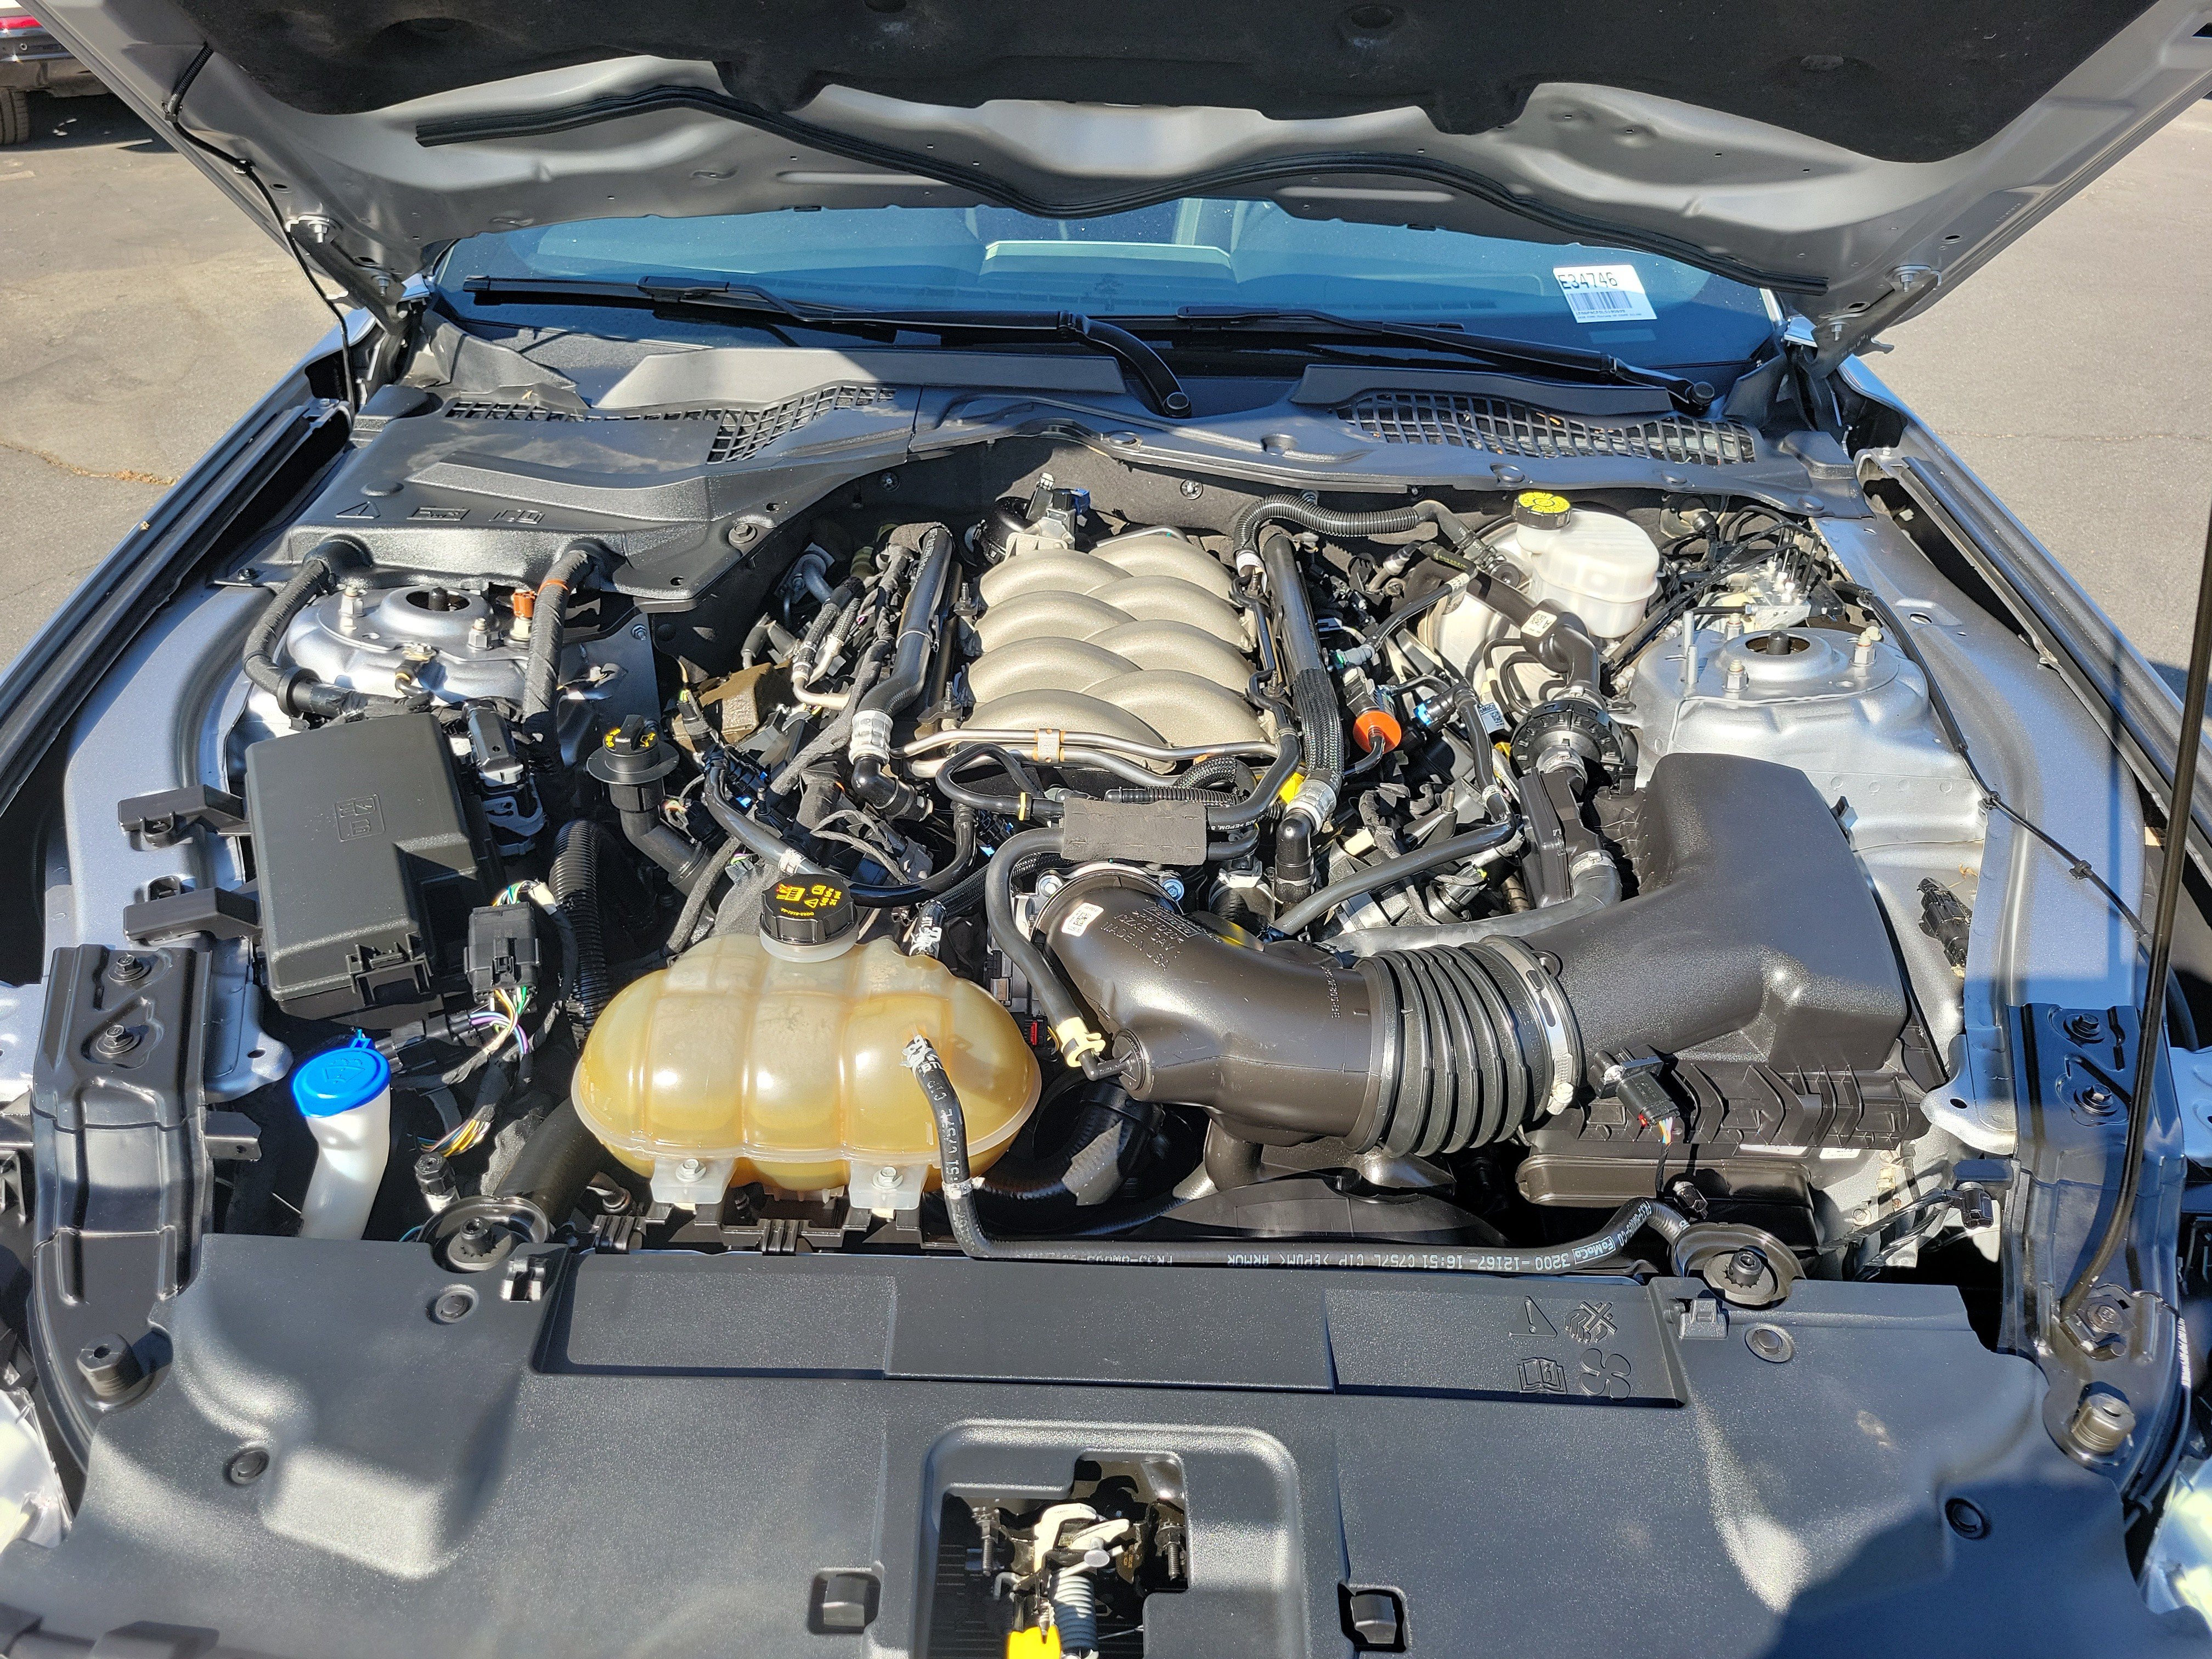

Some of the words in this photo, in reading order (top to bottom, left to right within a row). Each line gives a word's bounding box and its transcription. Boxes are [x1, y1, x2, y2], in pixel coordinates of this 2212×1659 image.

[1558, 272, 1617, 289] E34746
[1479, 704, 1496, 713] oMoCo
[1099, 921, 1136, 943] MADE
[1132, 939, 1148, 951] IN
[1146, 946, 1170, 972] USA
[1573, 1237, 1615, 1262] FoMoCo
[1227, 1254, 1269, 1266] ARMOR
[1339, 1254, 1364, 1266] CIP
[1374, 1254, 1415, 1268] C757L
[1423, 1254, 1463, 1269] 16:51
[1535, 1253, 1571, 1271] 3200
